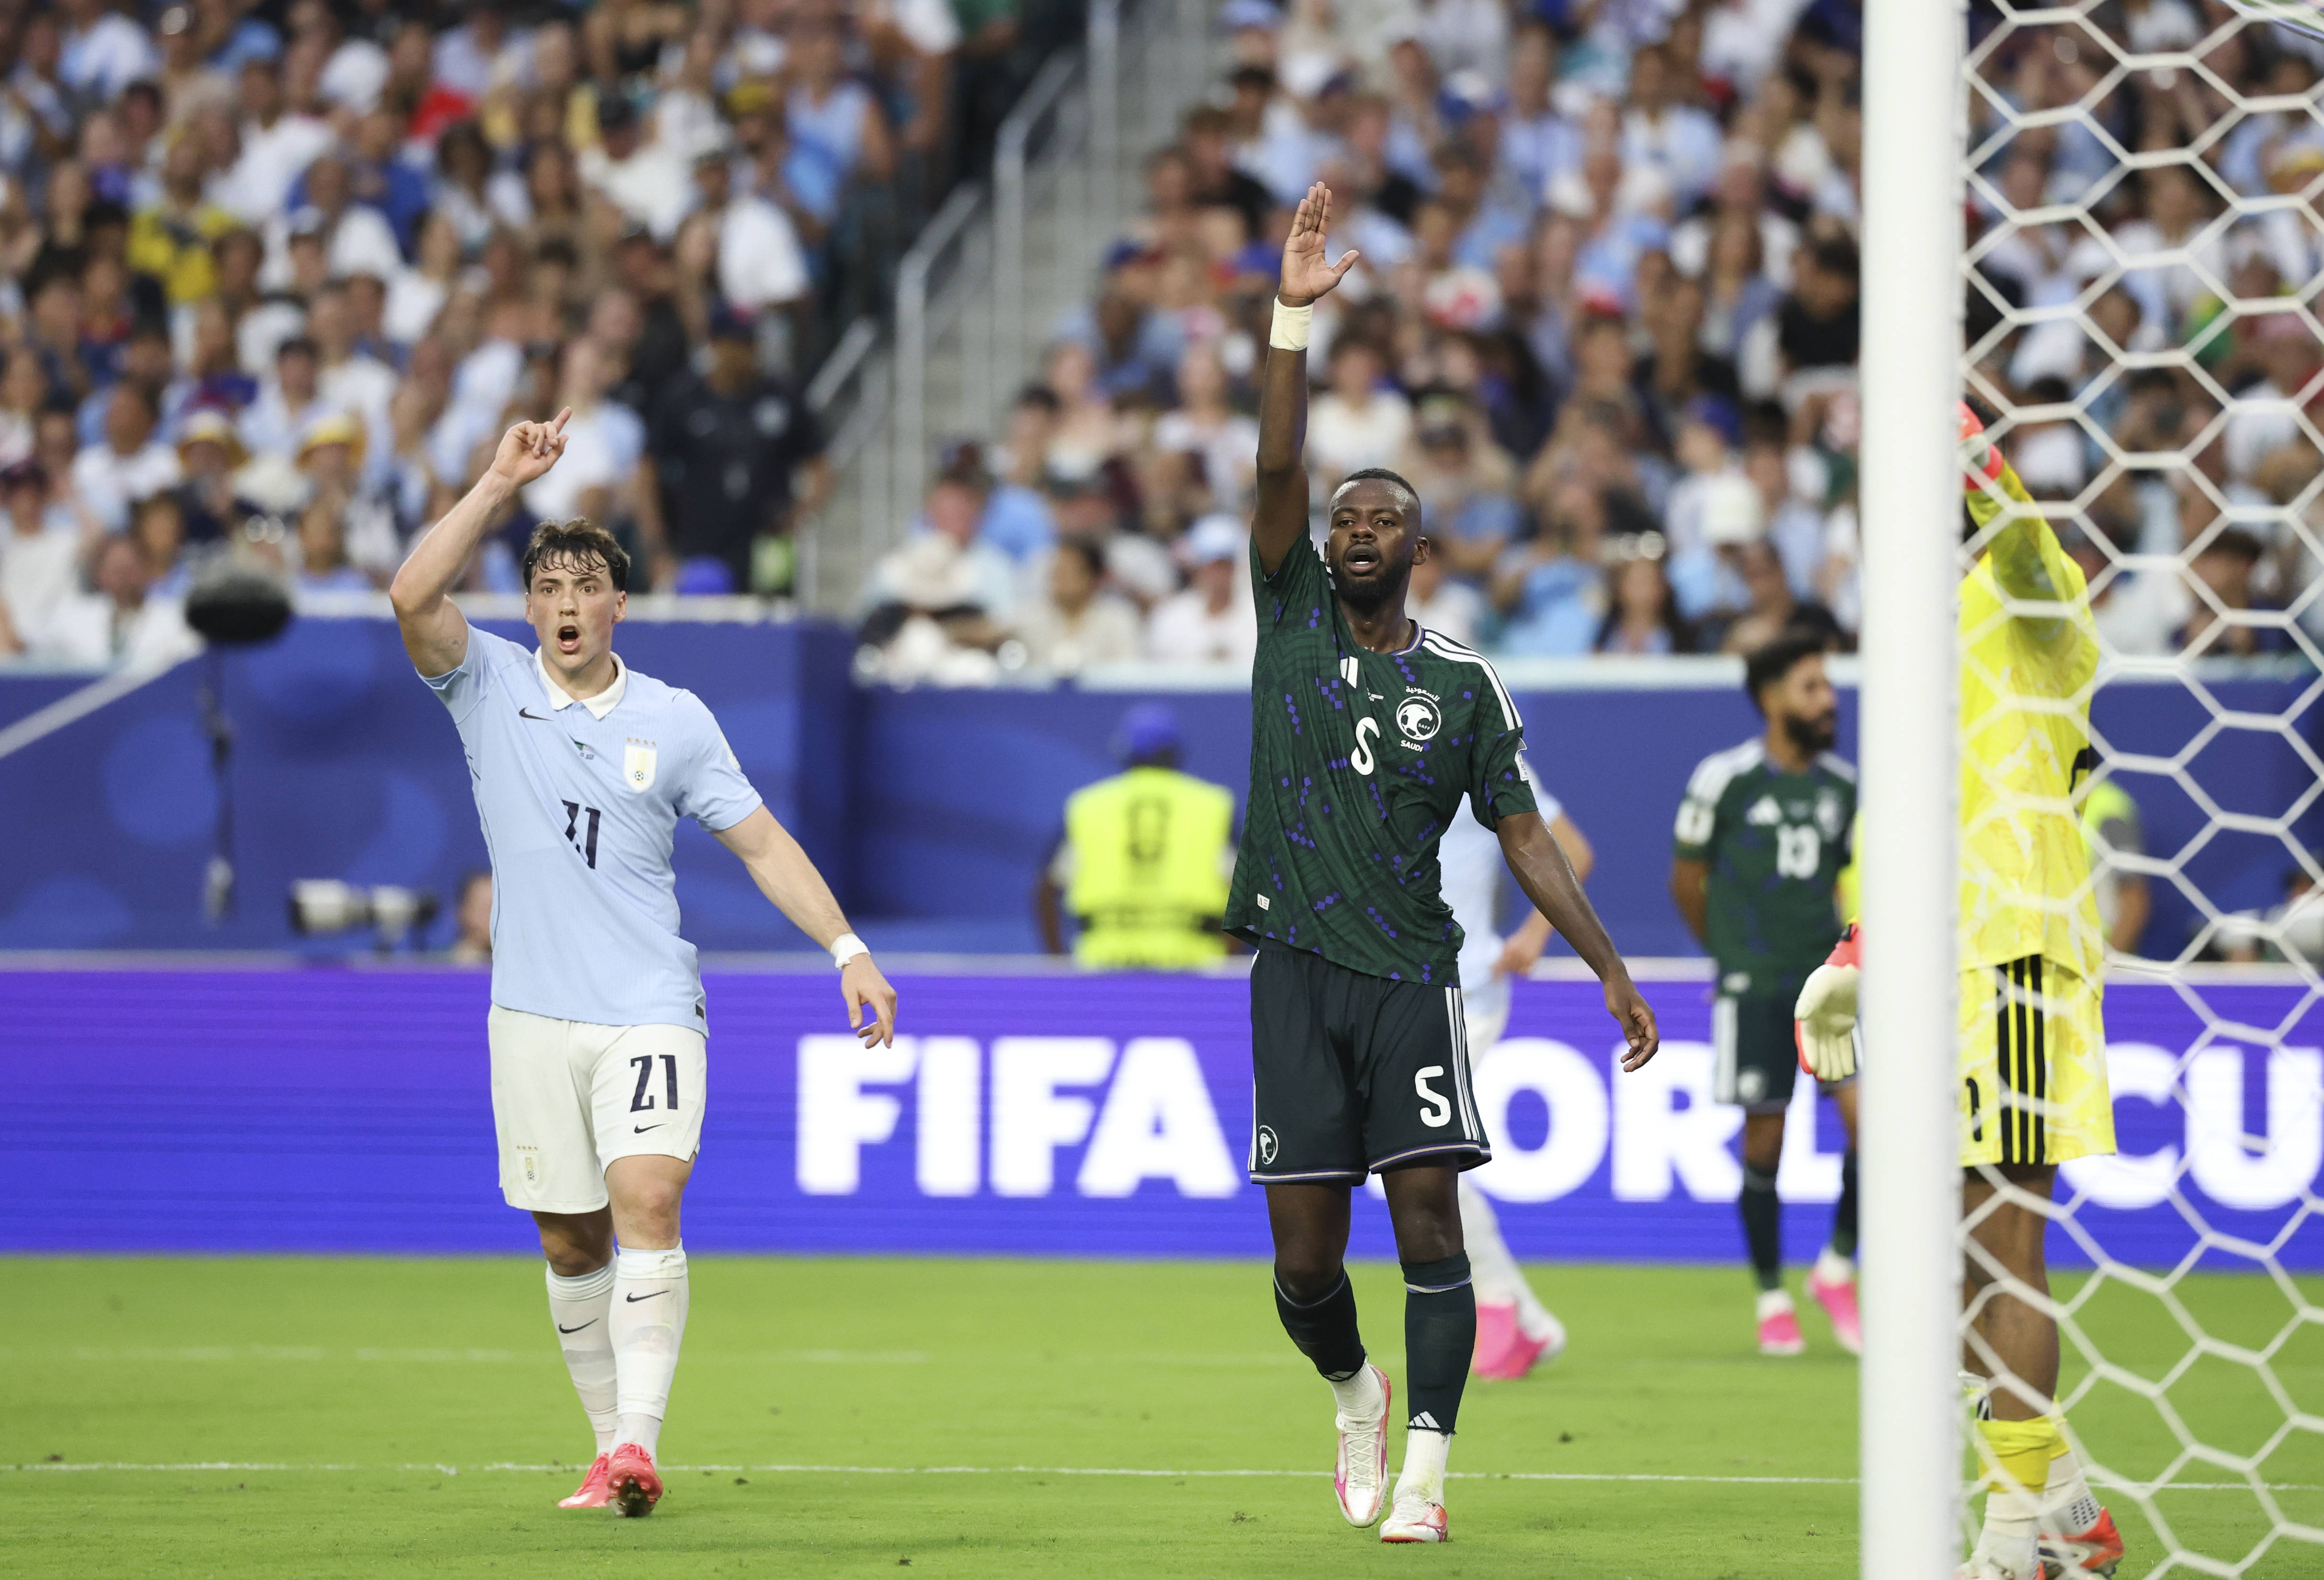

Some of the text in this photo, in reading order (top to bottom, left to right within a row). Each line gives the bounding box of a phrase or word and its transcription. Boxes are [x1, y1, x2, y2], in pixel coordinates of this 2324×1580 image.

[1406, 685, 1440, 702] السعودية
[1400, 739, 1424, 752] SAUDI
[1776, 823, 1821, 879] 13
[630, 1054, 678, 1113] 21
[1414, 1065, 1451, 1127] 5
[795, 1033, 1242, 1199] FIFA
[1365, 1036, 1845, 1204] ORL
